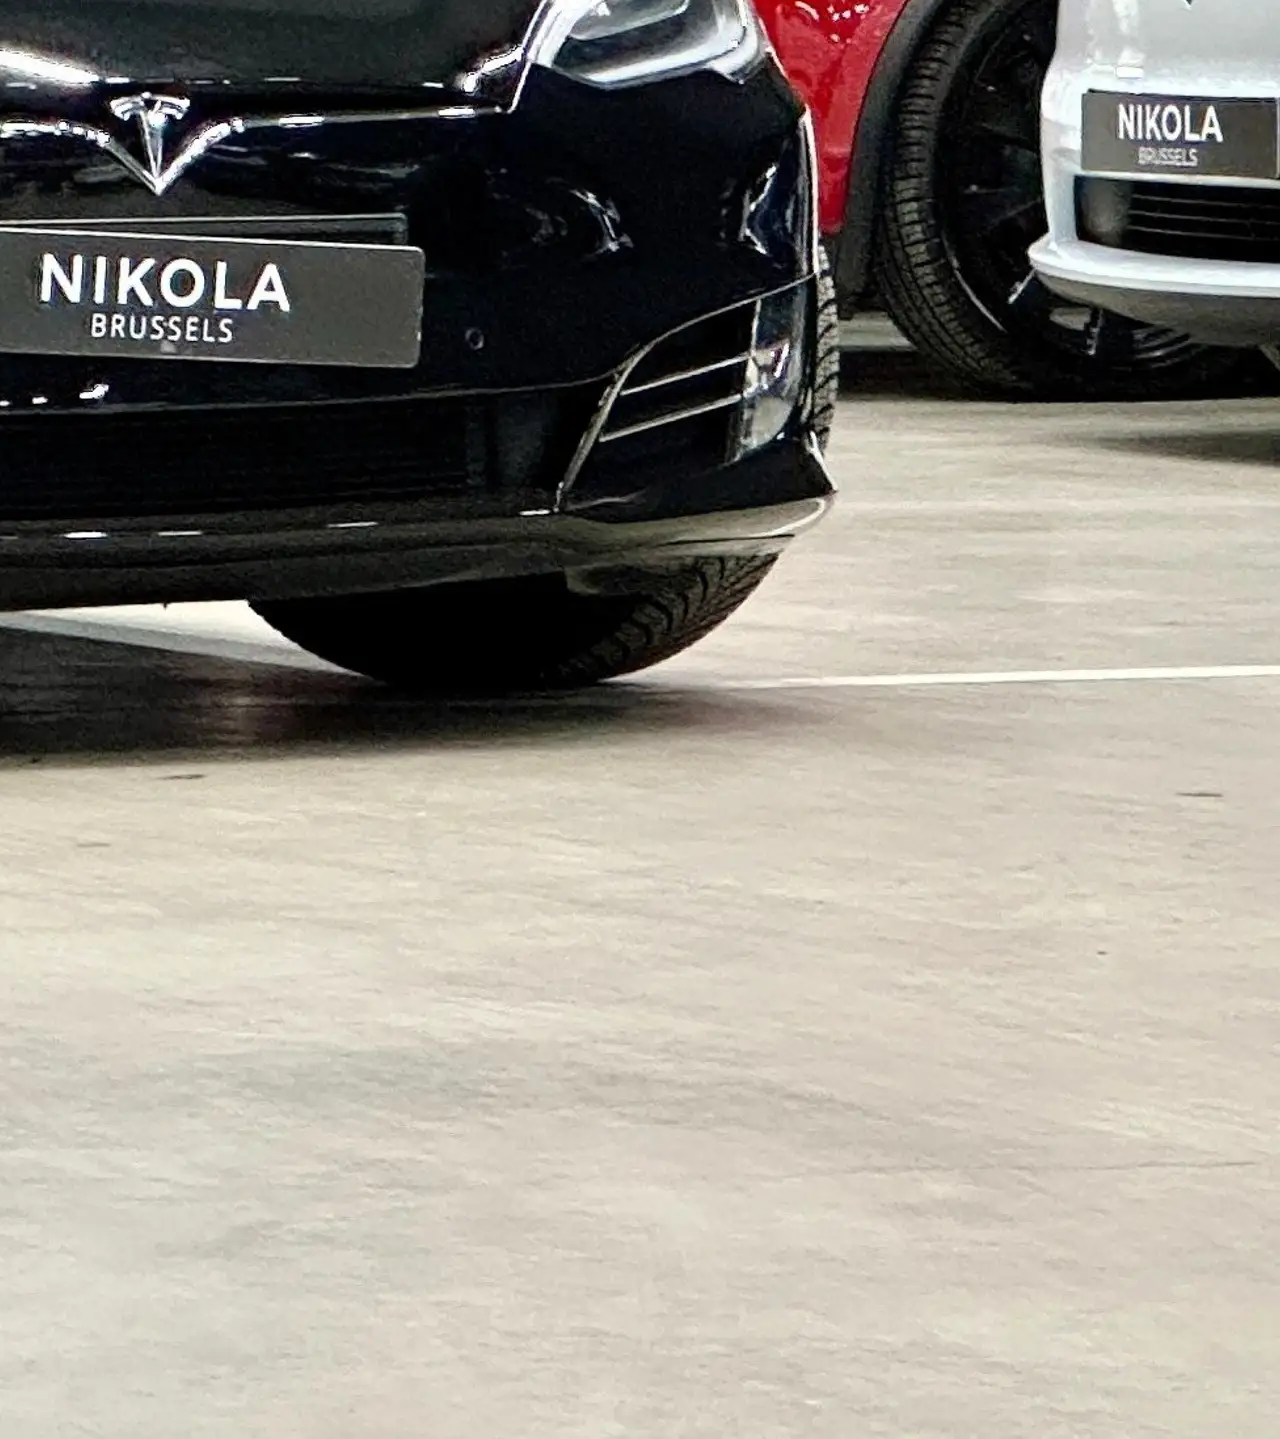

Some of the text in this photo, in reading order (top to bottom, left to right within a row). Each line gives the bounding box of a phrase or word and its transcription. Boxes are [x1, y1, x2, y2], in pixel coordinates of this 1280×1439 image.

[1117, 103, 1224, 143] NIKOLA
[40, 252, 291, 312] NIKOLA
[91, 313, 234, 343] BRUSSELS
